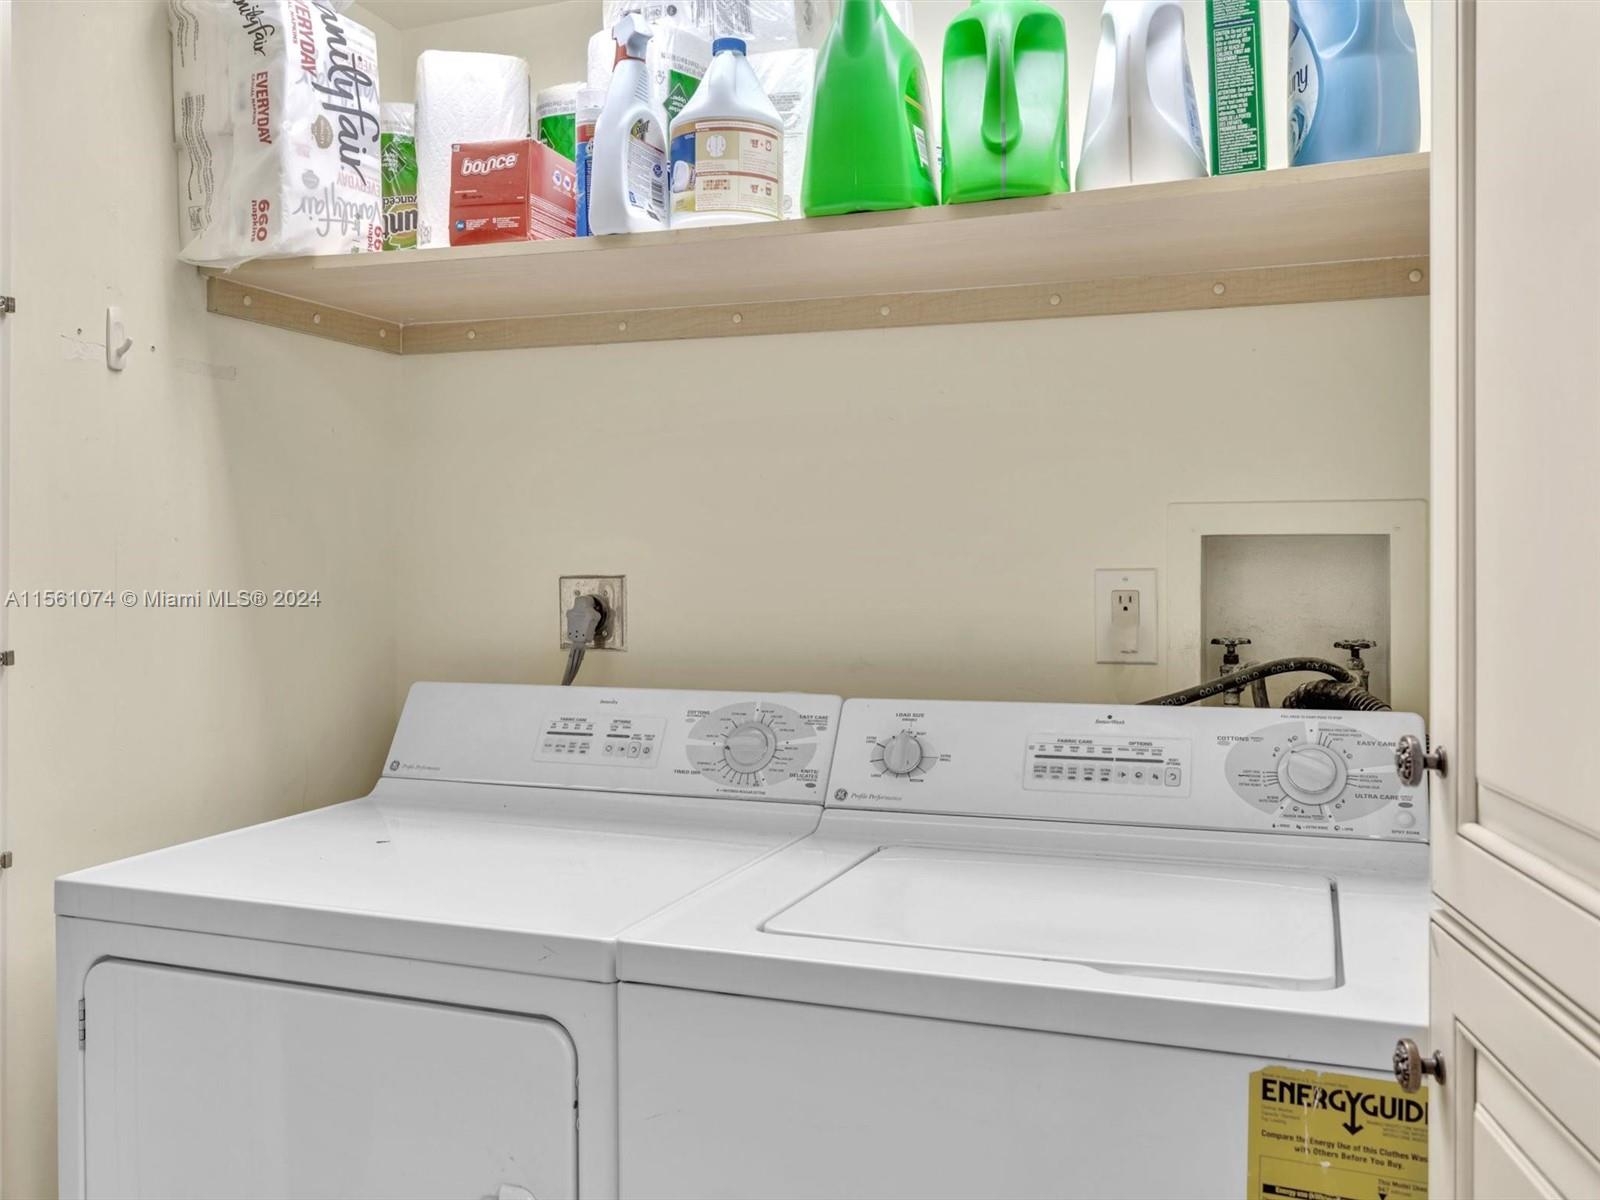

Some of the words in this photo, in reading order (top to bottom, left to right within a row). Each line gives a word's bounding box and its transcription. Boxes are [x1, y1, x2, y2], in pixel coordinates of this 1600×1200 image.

[254, 71, 272, 144] EVERYDAY
[462, 153, 518, 176] bounce
[256, 199, 270, 242] 660
[374, 225, 383, 251] 66
[1262, 1078, 1428, 1125] ENERGYGUID
[1261, 1129, 1294, 1142] Compare
[1309, 1137, 1335, 1149] Energy
[1379, 1148, 1409, 1160] Clothes
[1313, 1147, 1339, 1159] Others
[1341, 1151, 1367, 1163] Before
[1370, 1156, 1385, 1166] You
